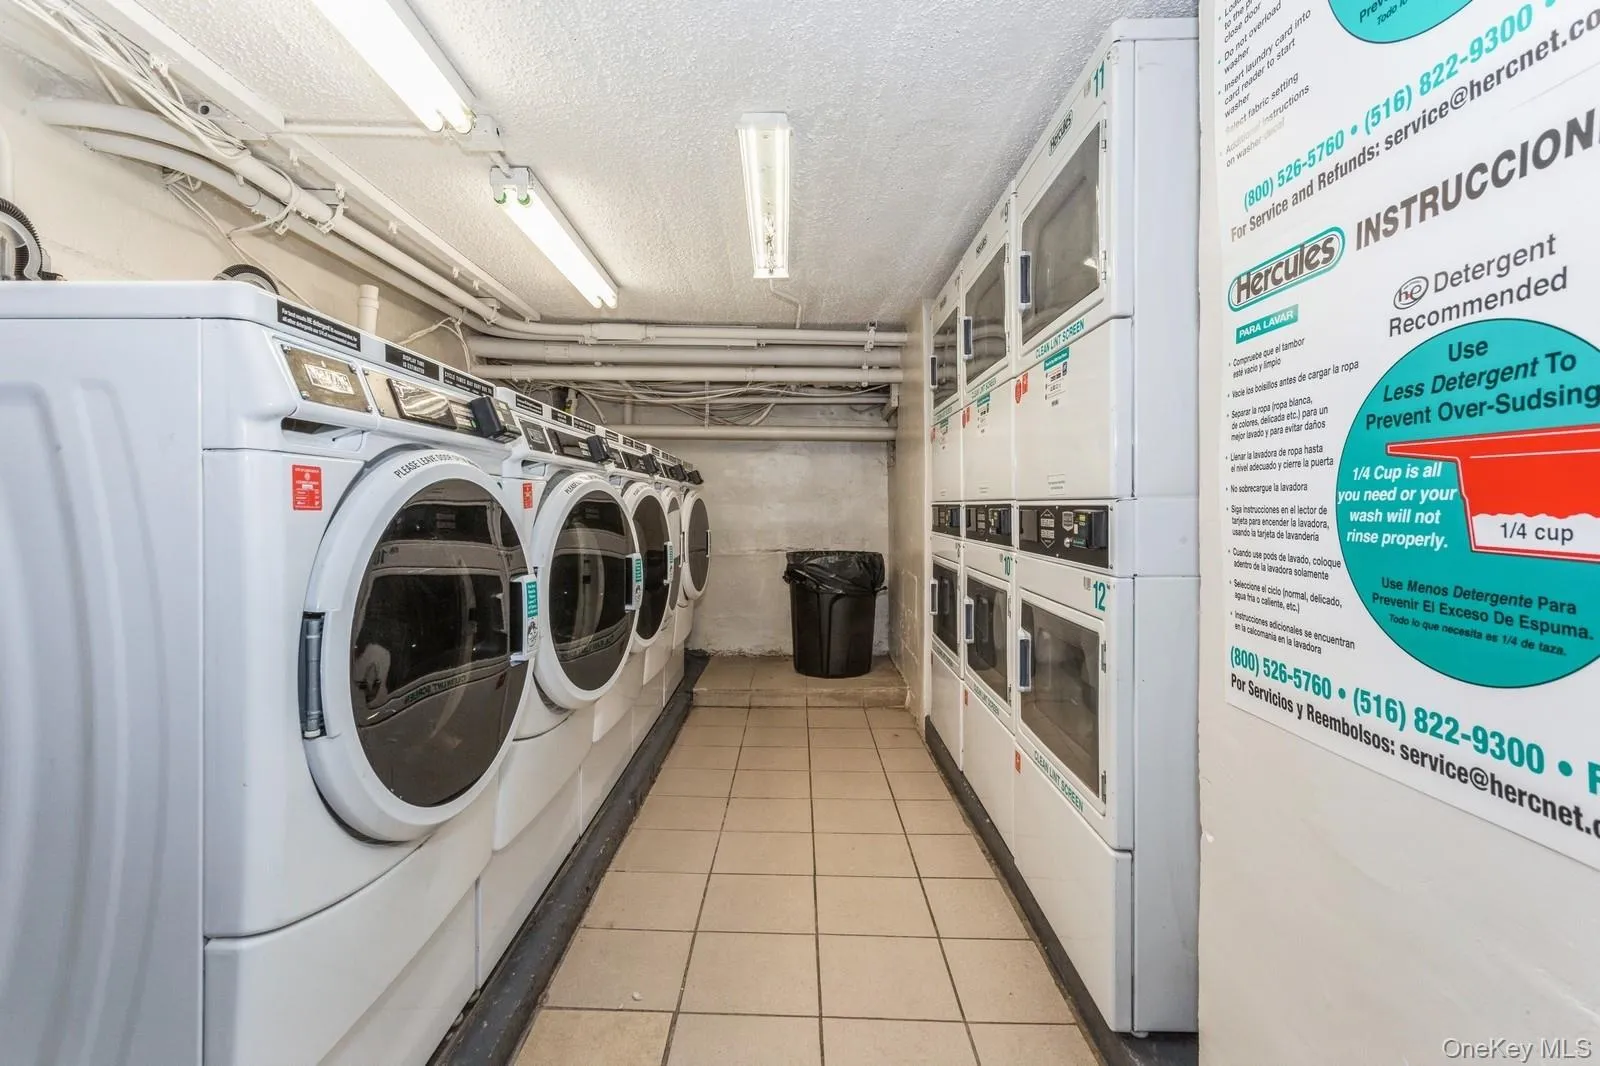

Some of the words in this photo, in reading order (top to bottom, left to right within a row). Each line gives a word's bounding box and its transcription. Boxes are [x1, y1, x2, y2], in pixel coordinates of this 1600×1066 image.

[1224, 48, 1235, 61] Do
[1249, 2, 1282, 38] overload
[1224, 69, 1245, 92] Insert
[1246, 44, 1273, 75] laundry
[1275, 24, 1293, 47] card
[1295, 9, 1311, 29] into
[1224, 46, 1250, 74] washer
[1241, 65, 1265, 92] reader
[1276, 38, 1296, 60] start
[1094, 59, 1106, 99] 11
[1271, 71, 1299, 101] setting
[1224, 93, 1251, 118] washer
[1244, 177, 1275, 213] (800)
[1276, 129, 1345, 189] 526-5760
[1364, 84, 1413, 136] (516)
[1419, 5, 1533, 97] 822-9300
[1230, 224, 1247, 243] For
[1248, 199, 1289, 232] Service
[1291, 181, 1315, 207] and
[1317, 144, 1381, 191] Refunds:
[1355, 107, 1600, 251] INSTRUCCION
[1235, 232, 1338, 305] Hercules
[1434, 233, 1557, 295] Detergent
[1388, 265, 1568, 338] Recommended
[1035, 345, 1050, 360] CLEAN
[1050, 335, 1062, 350] LINT
[1062, 318, 1085, 342] SCREEN
[1239, 319, 1263, 340] PARA
[1263, 309, 1295, 332] LAVAR
[1232, 350, 1263, 367] Compruebe
[1263, 347, 1275, 358] que
[1282, 337, 1306, 351] tambor
[1263, 356, 1282, 370] limpio
[1448, 339, 1490, 363] Use
[1255, 381, 1278, 394] bolsillos
[1279, 377, 1297, 387] antes
[1308, 366, 1332, 381] cargar
[1341, 359, 1360, 373] ropa
[1383, 381, 1426, 403] Less
[1430, 356, 1540, 395] Detergent
[1544, 350, 1577, 375] To
[1231, 407, 1252, 420] Separar
[1257, 402, 1271, 414] ropa
[1271, 399, 1288, 413] (ropa
[1288, 395, 1313, 408] blanca,
[1238, 417, 1260, 430] colores,
[1260, 412, 1285, 425] delicada
[1301, 408, 1318, 421] para
[1319, 405, 1329, 415] un
[1365, 407, 1432, 430] Prevent
[1437, 383, 1600, 422] Over-Sudsing
[1231, 430, 1246, 442] mejor
[1246, 427, 1265, 439] lavado
[1269, 425, 1285, 437] para
[1284, 422, 1303, 433] evitar
[1304, 419, 1326, 431] daños
[392, 458, 421, 480] PLEASE
[417, 453, 439, 467] LEAVE
[1230, 451, 1247, 462] Llenar
[1252, 447, 1278, 459] lavadora
[1287, 446, 1304, 458] ropa
[1304, 443, 1324, 454] hasta
[1236, 462, 1250, 473] nivel
[1249, 460, 1277, 471] adecuado
[1282, 458, 1302, 470] cierre
[1310, 456, 1335, 470] puerta
[1352, 466, 1372, 481] 1/4
[1373, 465, 1402, 482] Cup
[1405, 463, 1419, 479] is
[1422, 461, 1443, 478] all
[1238, 482, 1272, 495] sobrecargue
[1279, 480, 1309, 492] lavadora
[1337, 490, 1360, 505] you
[1363, 486, 1398, 501] need
[1400, 488, 1418, 501] or
[1419, 487, 1459, 505] your
[1231, 503, 1243, 515] Siga
[1242, 504, 1280, 515] instrucciones
[1297, 504, 1317, 515] lector
[1318, 504, 1328, 515] de
[1231, 515, 1248, 527] tarjeta
[1248, 517, 1262, 527] para
[1261, 516, 1290, 527] encender
[1297, 517, 1330, 531] lavadora,
[1349, 508, 1383, 523] wash
[1386, 508, 1412, 523] will
[1414, 509, 1442, 524] not
[1231, 527, 1251, 537] usando
[1256, 529, 1276, 540] tarjeta
[1346, 528, 1379, 544] rinse
[1380, 531, 1449, 552] properly.
[1499, 521, 1528, 540] 1/4
[1534, 526, 1574, 546] cup
[1003, 555, 1011, 577] 10
[1232, 546, 1252, 558] Cuando
[1252, 550, 1263, 560] use
[1262, 551, 1278, 563] pods
[1287, 552, 1311, 566] lavado,
[1312, 556, 1342, 570] coloque
[1233, 559, 1253, 570] adentro
[1266, 562, 1293, 576] lavadora
[1293, 566, 1329, 580] solamente
[1092, 580, 1107, 613] 12
[1233, 578, 1261, 593] Seleccione
[1267, 584, 1282, 597] ciclo
[1282, 587, 1309, 603] (normal,
[1309, 592, 1342, 609] delicado,
[1261, 596, 1285, 610] caliente,
[1380, 576, 1404, 591] Use
[1407, 579, 1449, 597] Menos
[1452, 585, 1533, 609] Detergente
[1537, 595, 1578, 616] Para
[1234, 610, 1269, 628] Instrucciones
[1268, 618, 1303, 637] adicionales
[1313, 630, 1356, 650] encuentran
[1371, 591, 1420, 611] Prevenir
[1421, 599, 1436, 614] El
[1438, 601, 1490, 623] Exceso
[1492, 610, 1515, 627] De
[1518, 614, 1595, 641] Espuma.
[1293, 637, 1323, 656] lavadora
[1389, 612, 1411, 626] Todo
[1411, 616, 1421, 628] lo
[1421, 620, 1440, 633] que
[1440, 624, 1483, 641] necesita
[1484, 632, 1499, 644] es
[1501, 634, 1519, 647] 1/4
[1520, 638, 1536, 651] de
[1537, 642, 1568, 657] taza.
[1230, 645, 1260, 678] (800)
[1262, 657, 1333, 701] 526-5760
[1352, 687, 1408, 732] (516)
[1413, 706, 1546, 776] 822-9300
[1230, 673, 1247, 693] Por
[1247, 679, 1294, 715] Servicios
[1295, 702, 1305, 721] y
[1305, 704, 1397, 756] Reembolsos:
[1034, 749, 1049, 774] CLEAN
[1049, 766, 1061, 785] LINT
[1060, 780, 1084, 812] SCREEN
